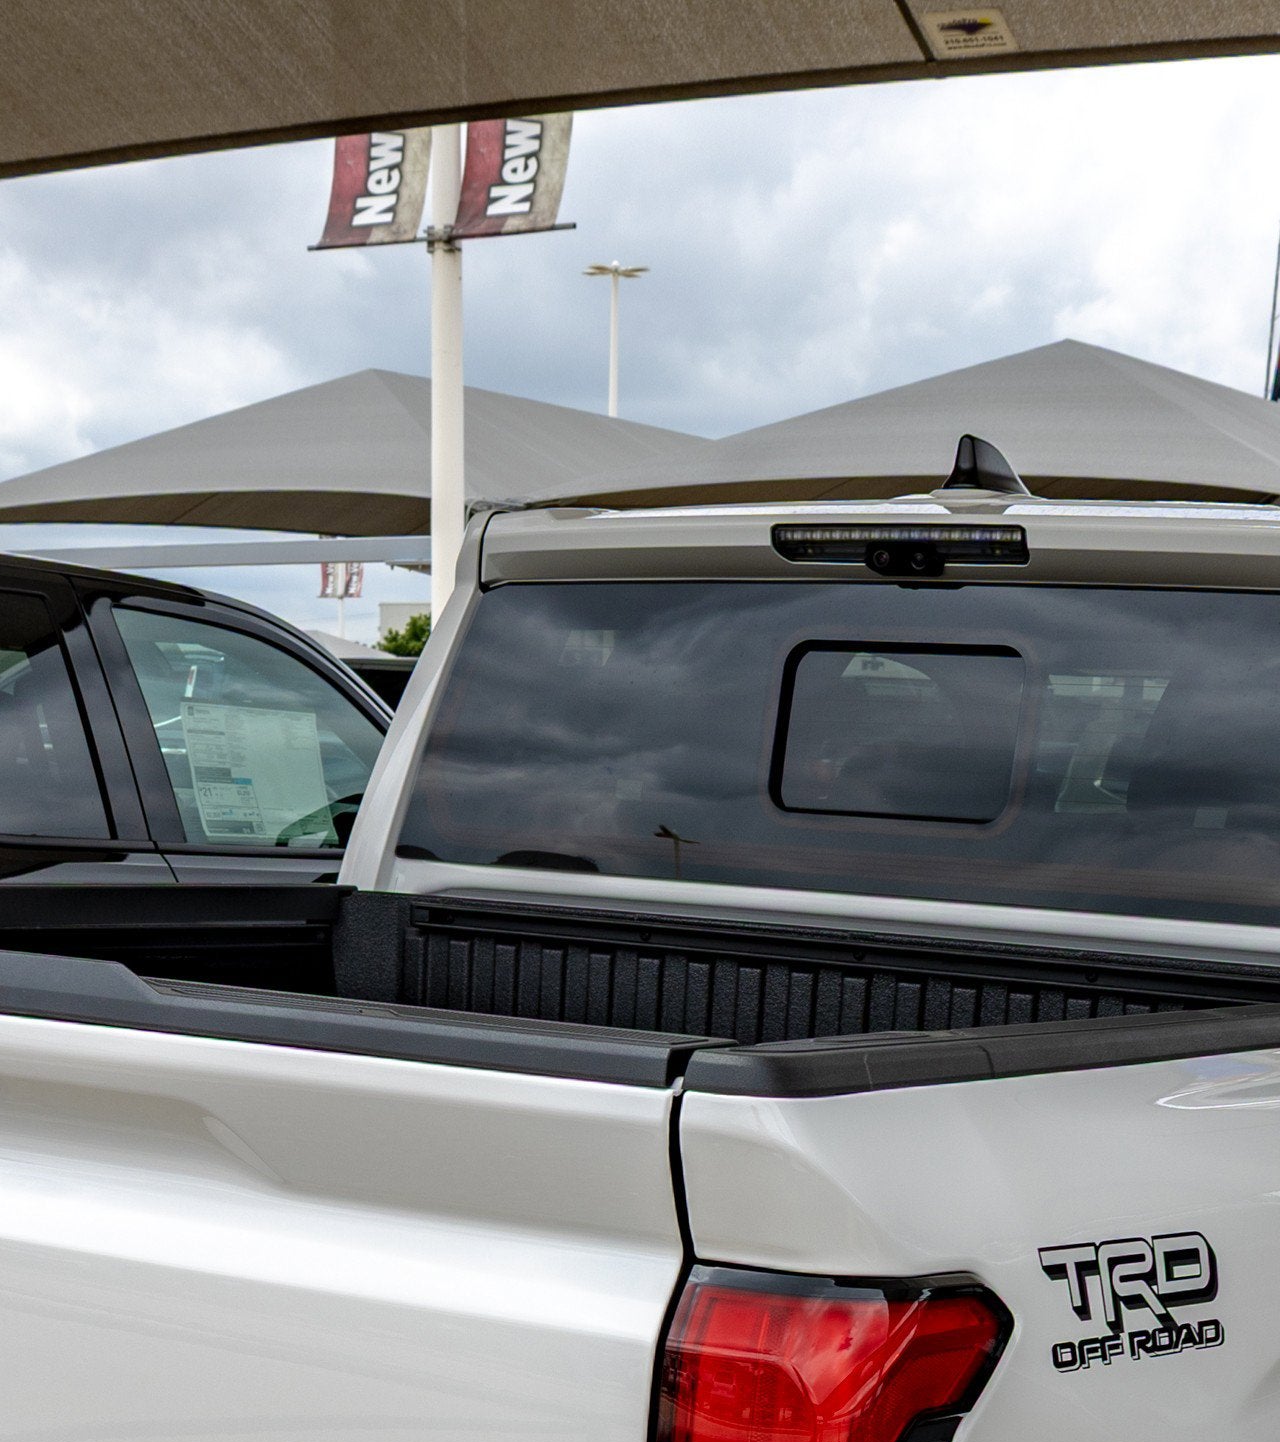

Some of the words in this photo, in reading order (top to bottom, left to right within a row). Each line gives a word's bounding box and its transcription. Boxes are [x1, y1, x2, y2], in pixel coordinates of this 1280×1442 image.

[351, 132, 404, 226] New
[486, 119, 542, 215] New
[1037, 1231, 1219, 1334] TRD
[1051, 1333, 1124, 1373] OFF
[1128, 1319, 1224, 1360] ROAD
